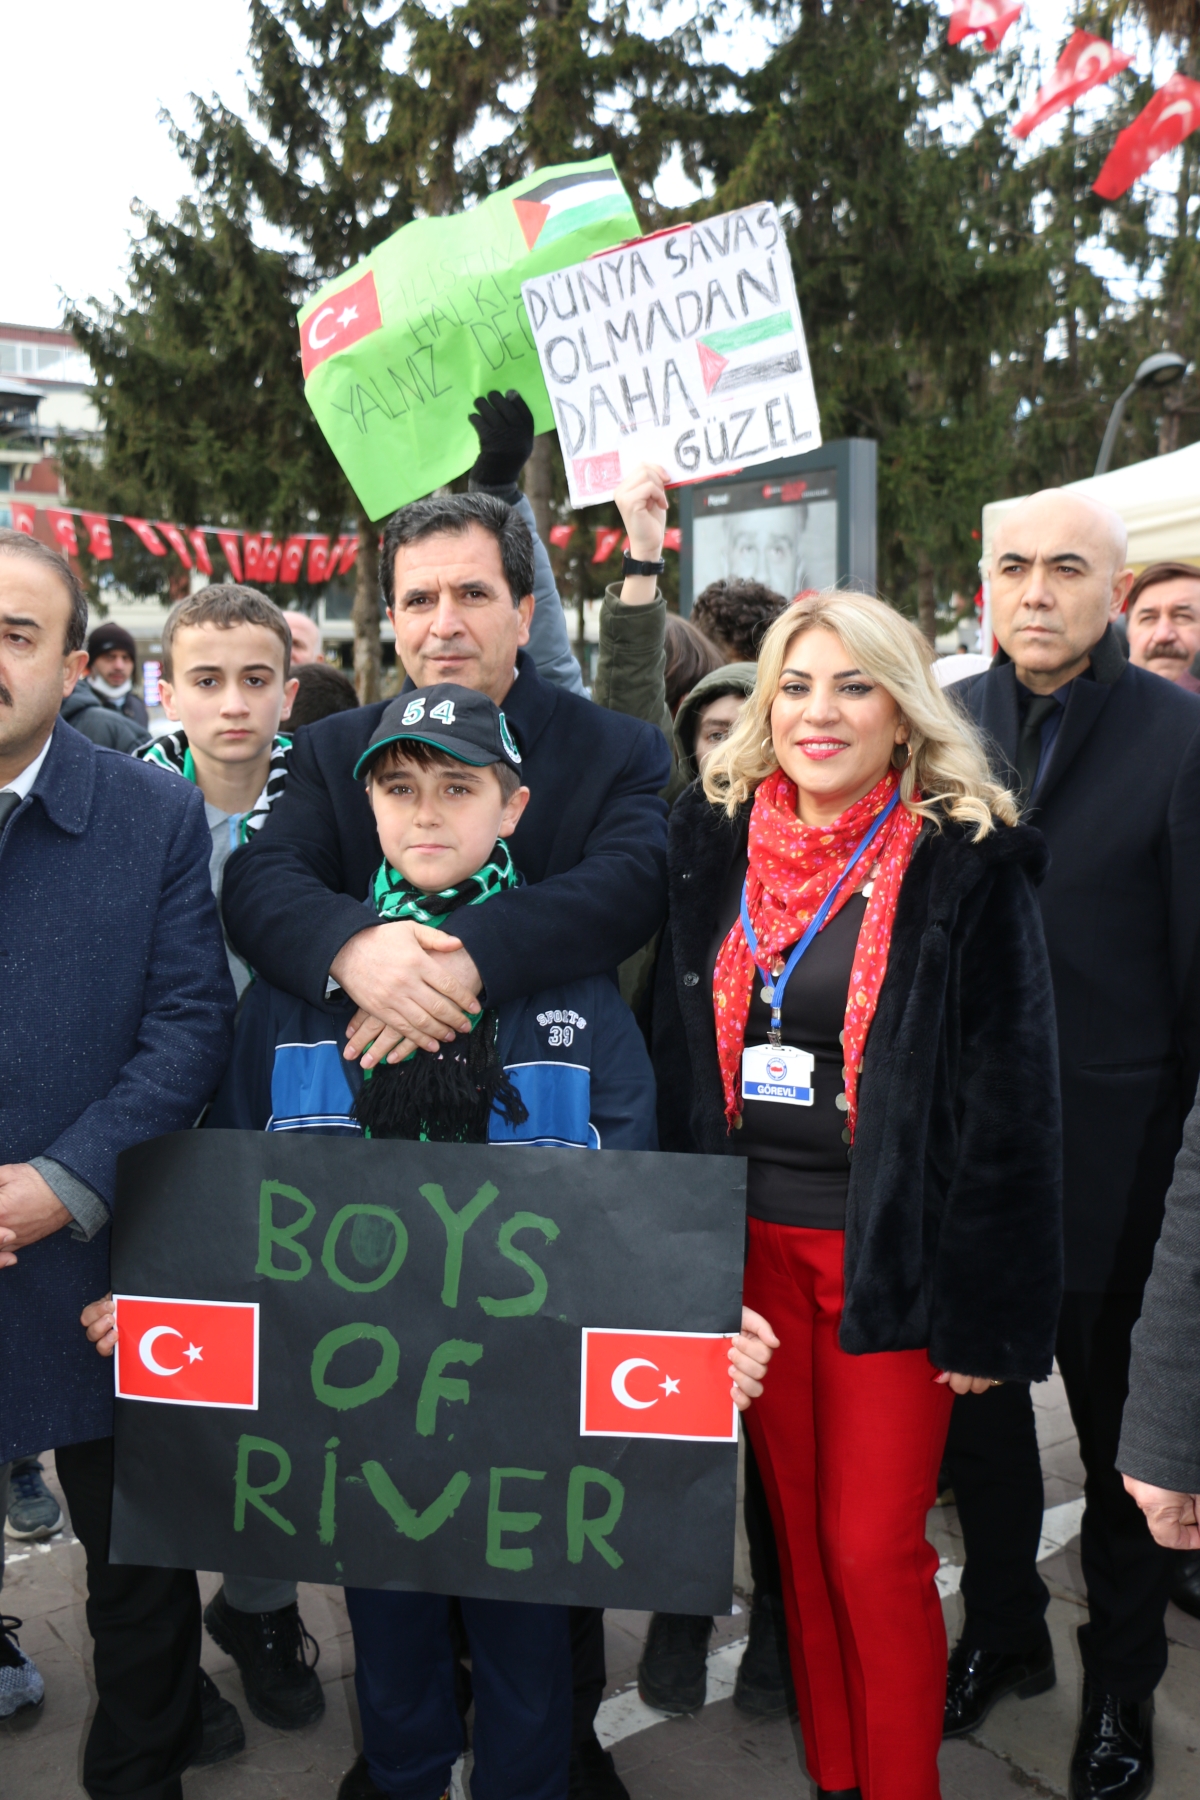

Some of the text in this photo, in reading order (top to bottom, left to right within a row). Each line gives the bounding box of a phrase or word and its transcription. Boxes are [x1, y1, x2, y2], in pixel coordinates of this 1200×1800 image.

[525, 251, 655, 331] DÜNYA
[545, 257, 780, 384] OLMADAN
[555, 358, 700, 459] DAHA
[674, 392, 812, 473] GÜZEL
[536, 1010, 587, 1029] SPORTS
[548, 1026, 574, 1047] 39
[757, 1084, 796, 1098] GÖREVLİ
[255, 1179, 561, 1318] BOYS
[310, 1321, 484, 1437] OF
